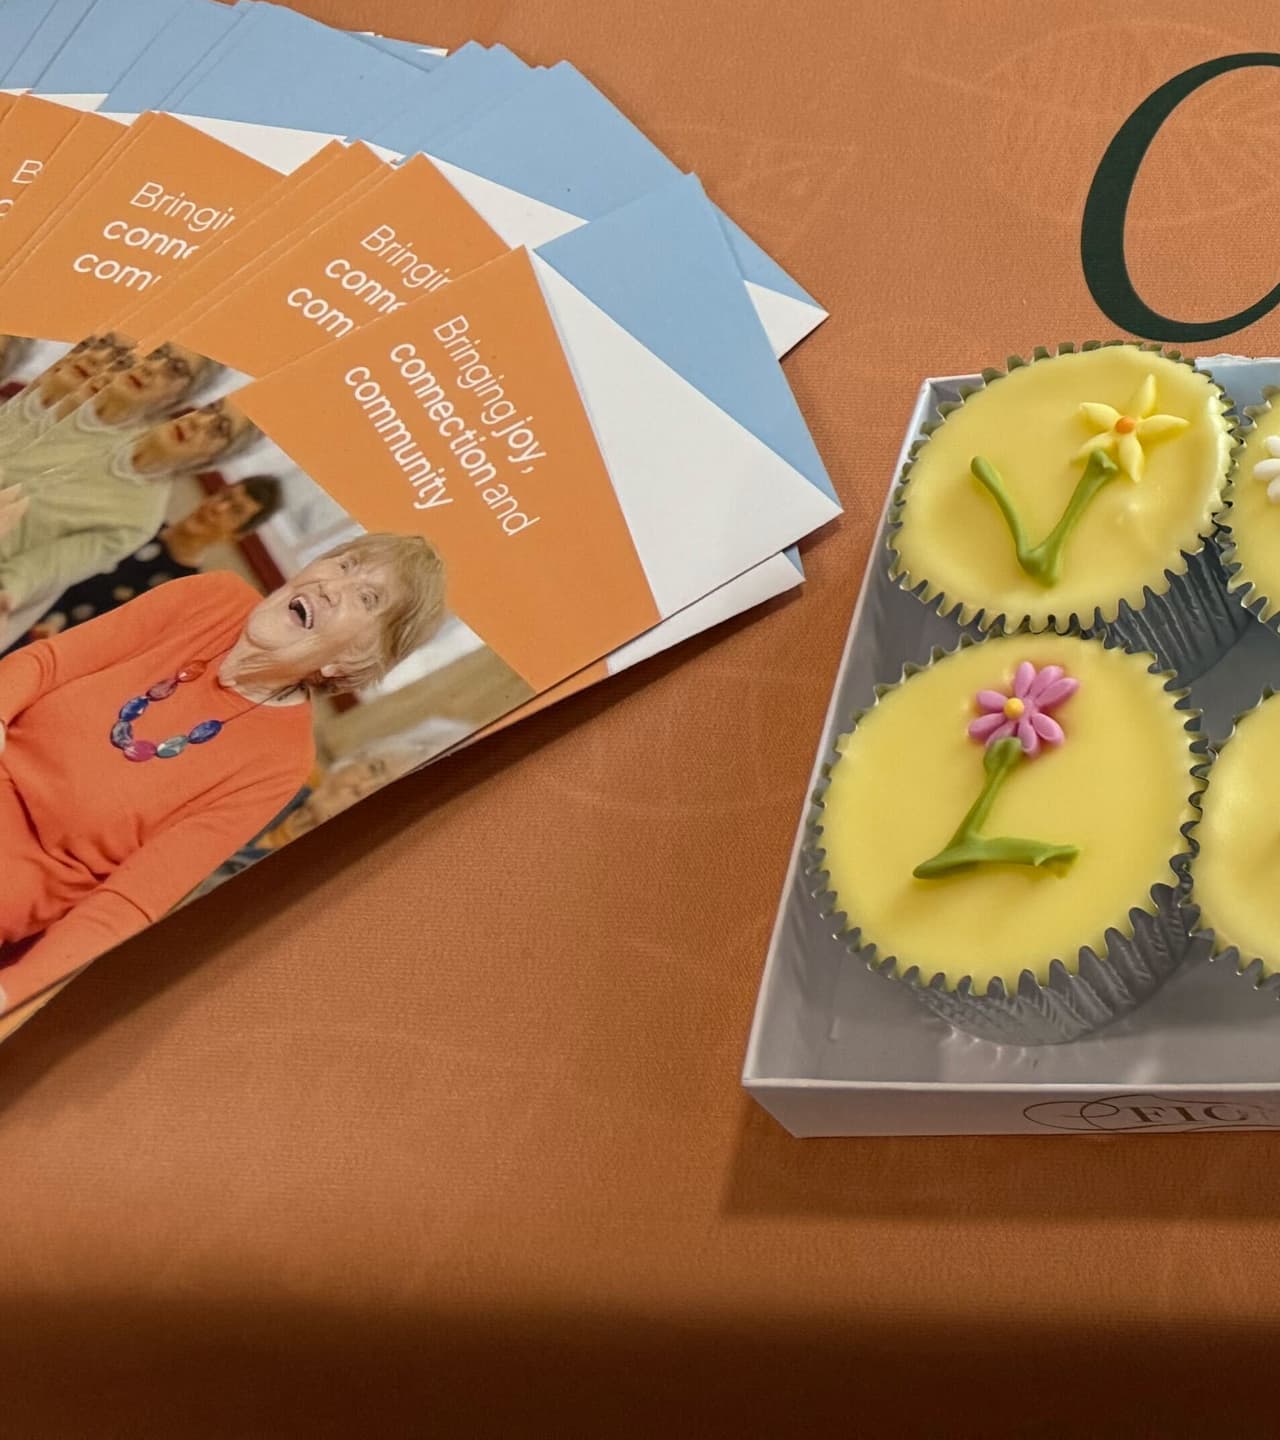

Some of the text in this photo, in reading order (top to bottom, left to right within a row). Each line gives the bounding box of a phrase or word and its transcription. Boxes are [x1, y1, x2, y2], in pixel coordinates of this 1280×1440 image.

[344, 366, 454, 510] community
[390, 343, 541, 536] connection and
[433, 314, 547, 474] Bringing joy,
